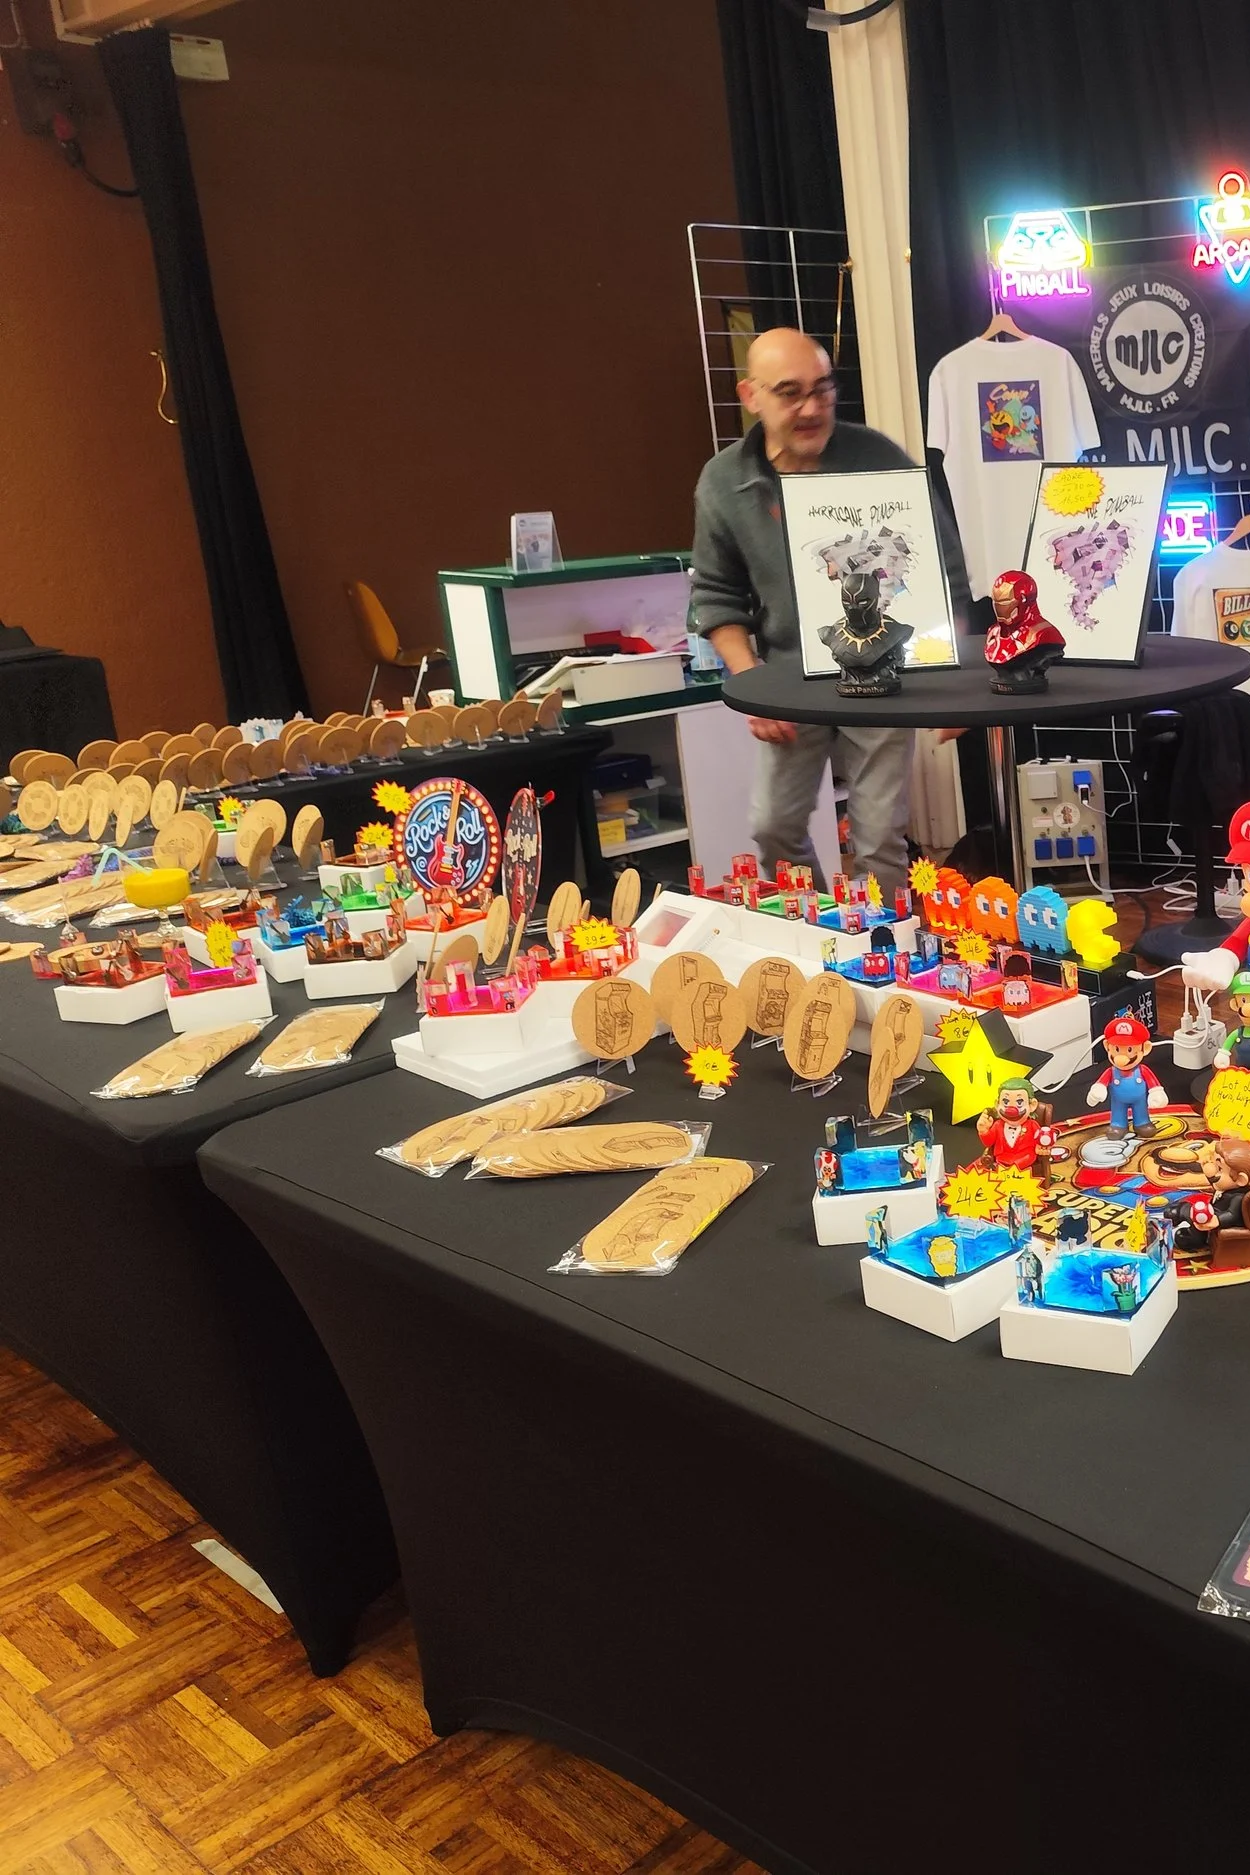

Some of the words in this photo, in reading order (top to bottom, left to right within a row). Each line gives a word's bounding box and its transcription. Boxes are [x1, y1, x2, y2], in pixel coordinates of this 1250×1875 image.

[1001, 269, 1089, 298] PINBALL
[1144, 281, 1190, 311] LOISIRS
[1110, 284, 1138, 313] JEUX
[1183, 312, 1206, 388] CREATIONS
[808, 504, 863, 527] HURRICANE
[870, 501, 912, 527] PINBALL
[1104, 494, 1145, 519] PINBALL
[405, 806, 447, 858] Rock
[455, 807, 486, 845] Roll
